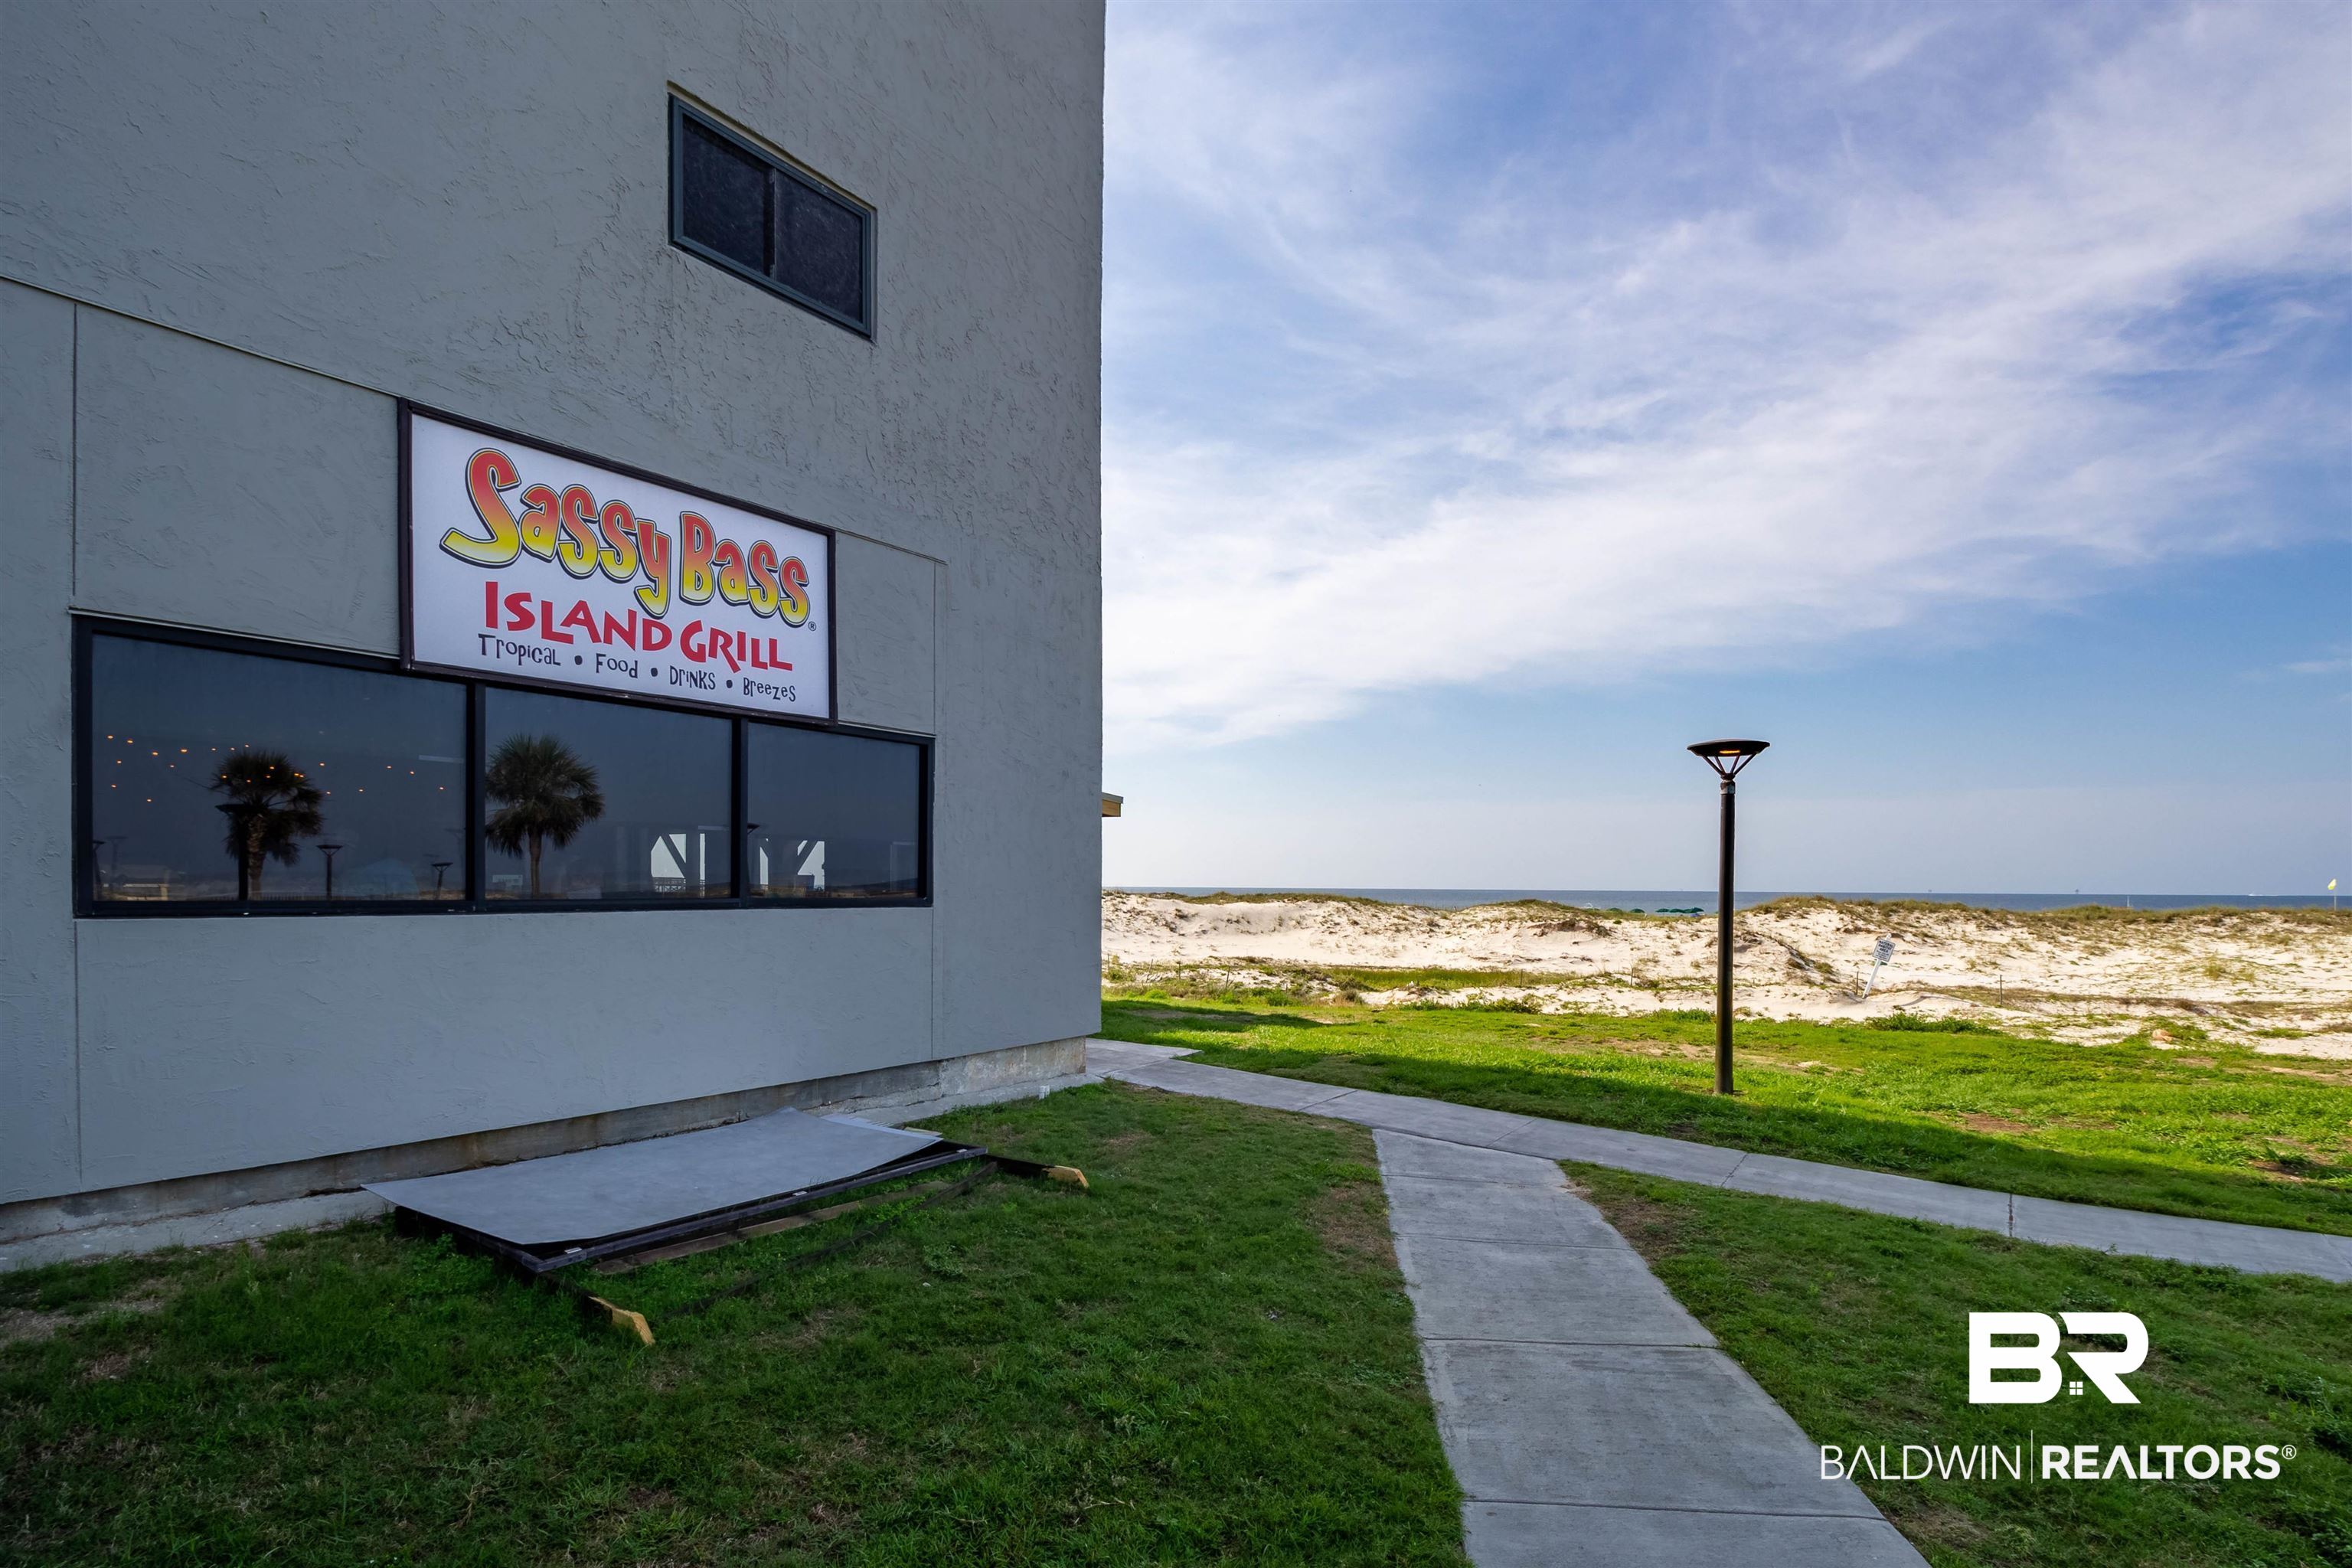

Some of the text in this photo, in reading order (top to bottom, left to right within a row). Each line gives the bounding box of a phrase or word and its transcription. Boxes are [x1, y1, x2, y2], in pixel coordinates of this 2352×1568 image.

[439, 447, 671, 619] Sassy
[485, 581, 793, 674] ISLAND GRILL
[596, 653, 638, 678] Food
